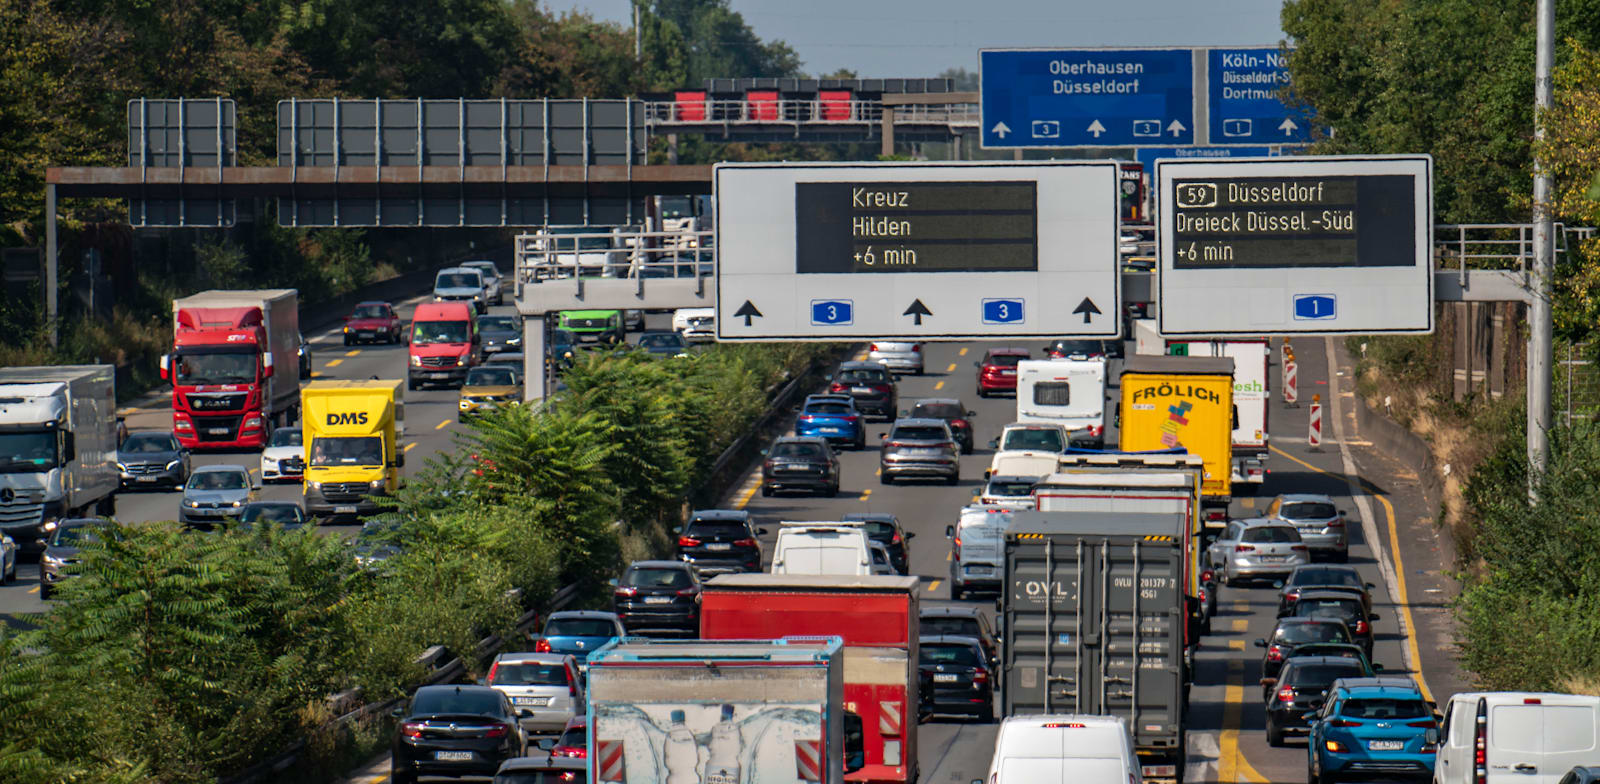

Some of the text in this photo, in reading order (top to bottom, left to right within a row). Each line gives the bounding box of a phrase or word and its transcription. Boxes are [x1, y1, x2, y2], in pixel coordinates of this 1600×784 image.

[1049, 60, 1143, 75] Oberhausen
[1222, 53, 1288, 68] Köln-No
[1223, 71, 1291, 84] Düsseldorf-S
[1053, 79, 1139, 94] Düsseldorf
[1223, 87, 1279, 100] Dortmu
[1042, 124, 1049, 135] 3
[1143, 123, 1151, 134] 3
[1236, 122, 1241, 134] 1
[1175, 148, 1231, 157] Oberhausen
[852, 187, 909, 208] Kreuz
[1187, 181, 1324, 204] 59 Düsseldorf
[852, 215, 911, 237] Hilden
[1177, 210, 1354, 233] Dreieck Düssel.-Süd
[853, 244, 917, 265] +6 min
[1177, 240, 1234, 261] +6 min
[827, 304, 837, 321] 3
[998, 303, 1009, 319] 3
[1311, 299, 1319, 315] 1
[1132, 382, 1220, 405] FRÖLICH
[1234, 379, 1263, 393] esh
[326, 412, 369, 426] DMS
[1025, 581, 1068, 596] OVL
[1114, 578, 1132, 588] OVLU
[1140, 578, 1165, 588] 201379
